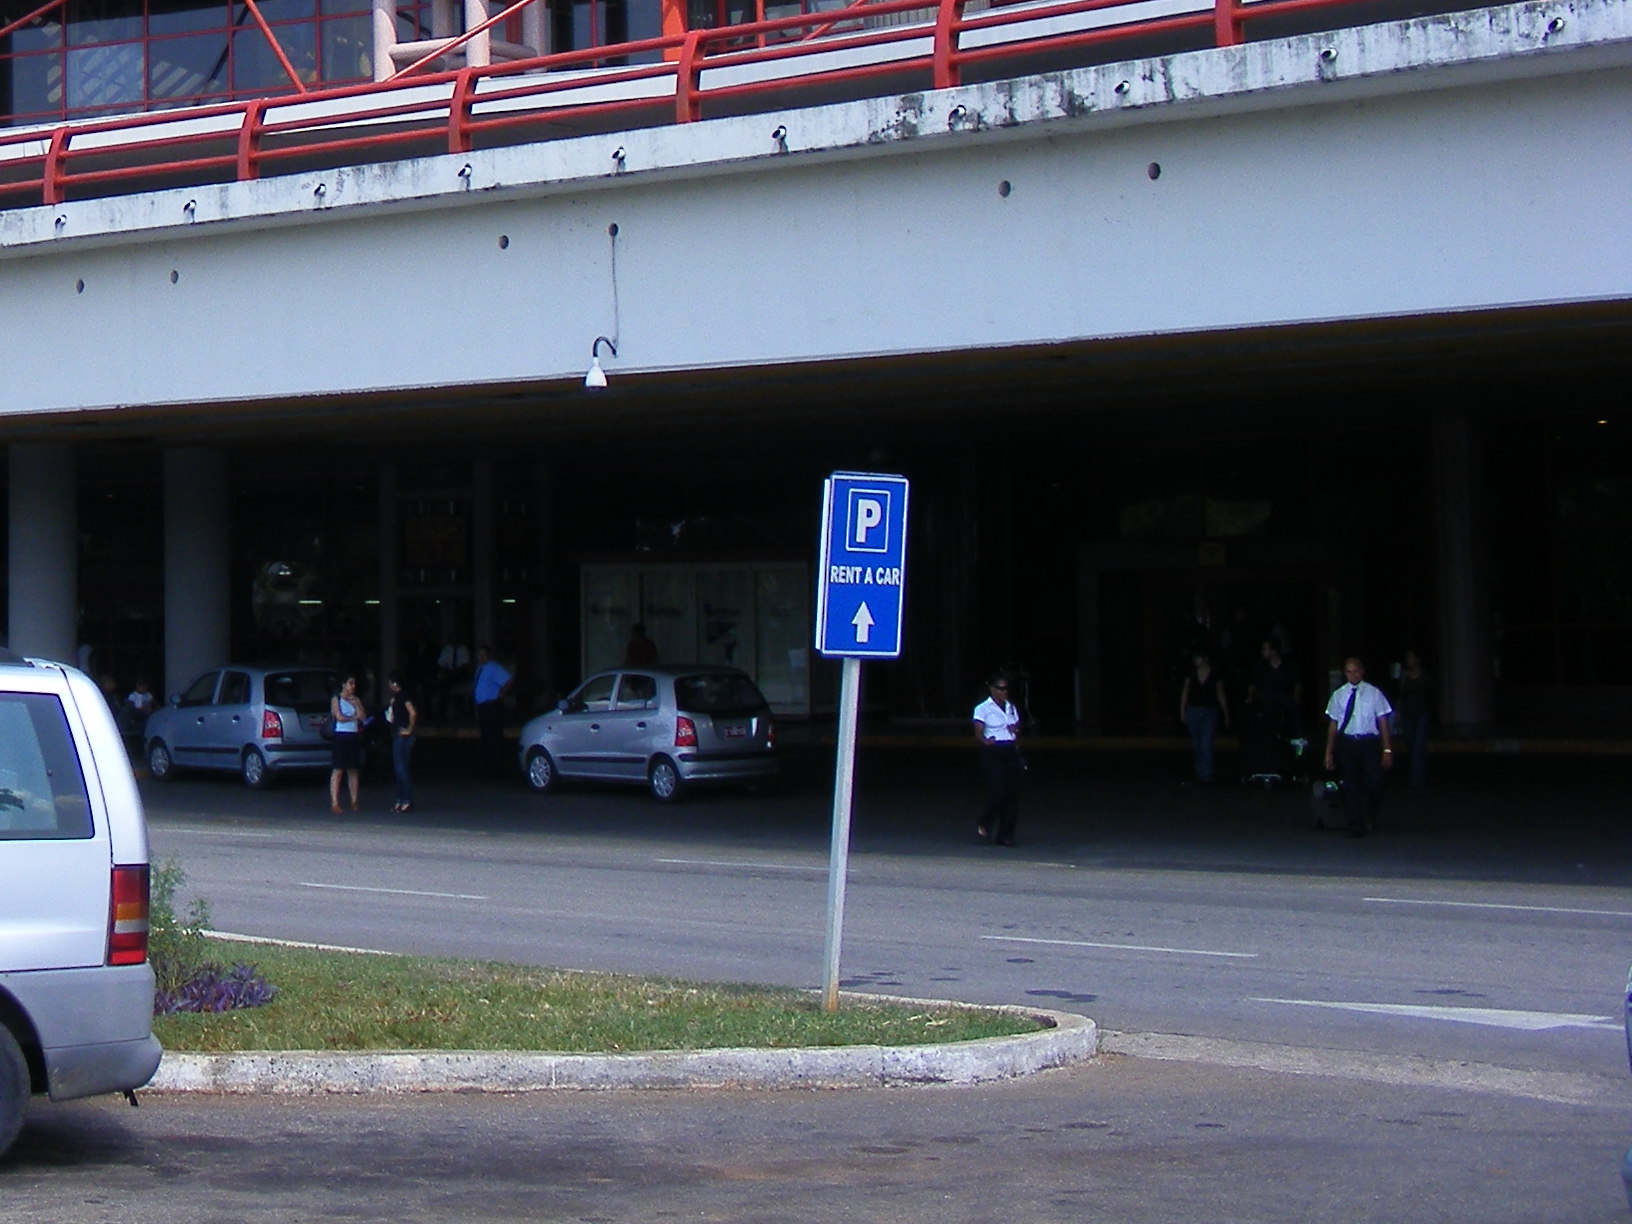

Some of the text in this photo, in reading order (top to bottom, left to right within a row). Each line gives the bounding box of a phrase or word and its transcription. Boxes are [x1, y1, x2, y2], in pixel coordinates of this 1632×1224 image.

[855, 498, 882, 543] P
[830, 565, 900, 586] RENT A CAR
